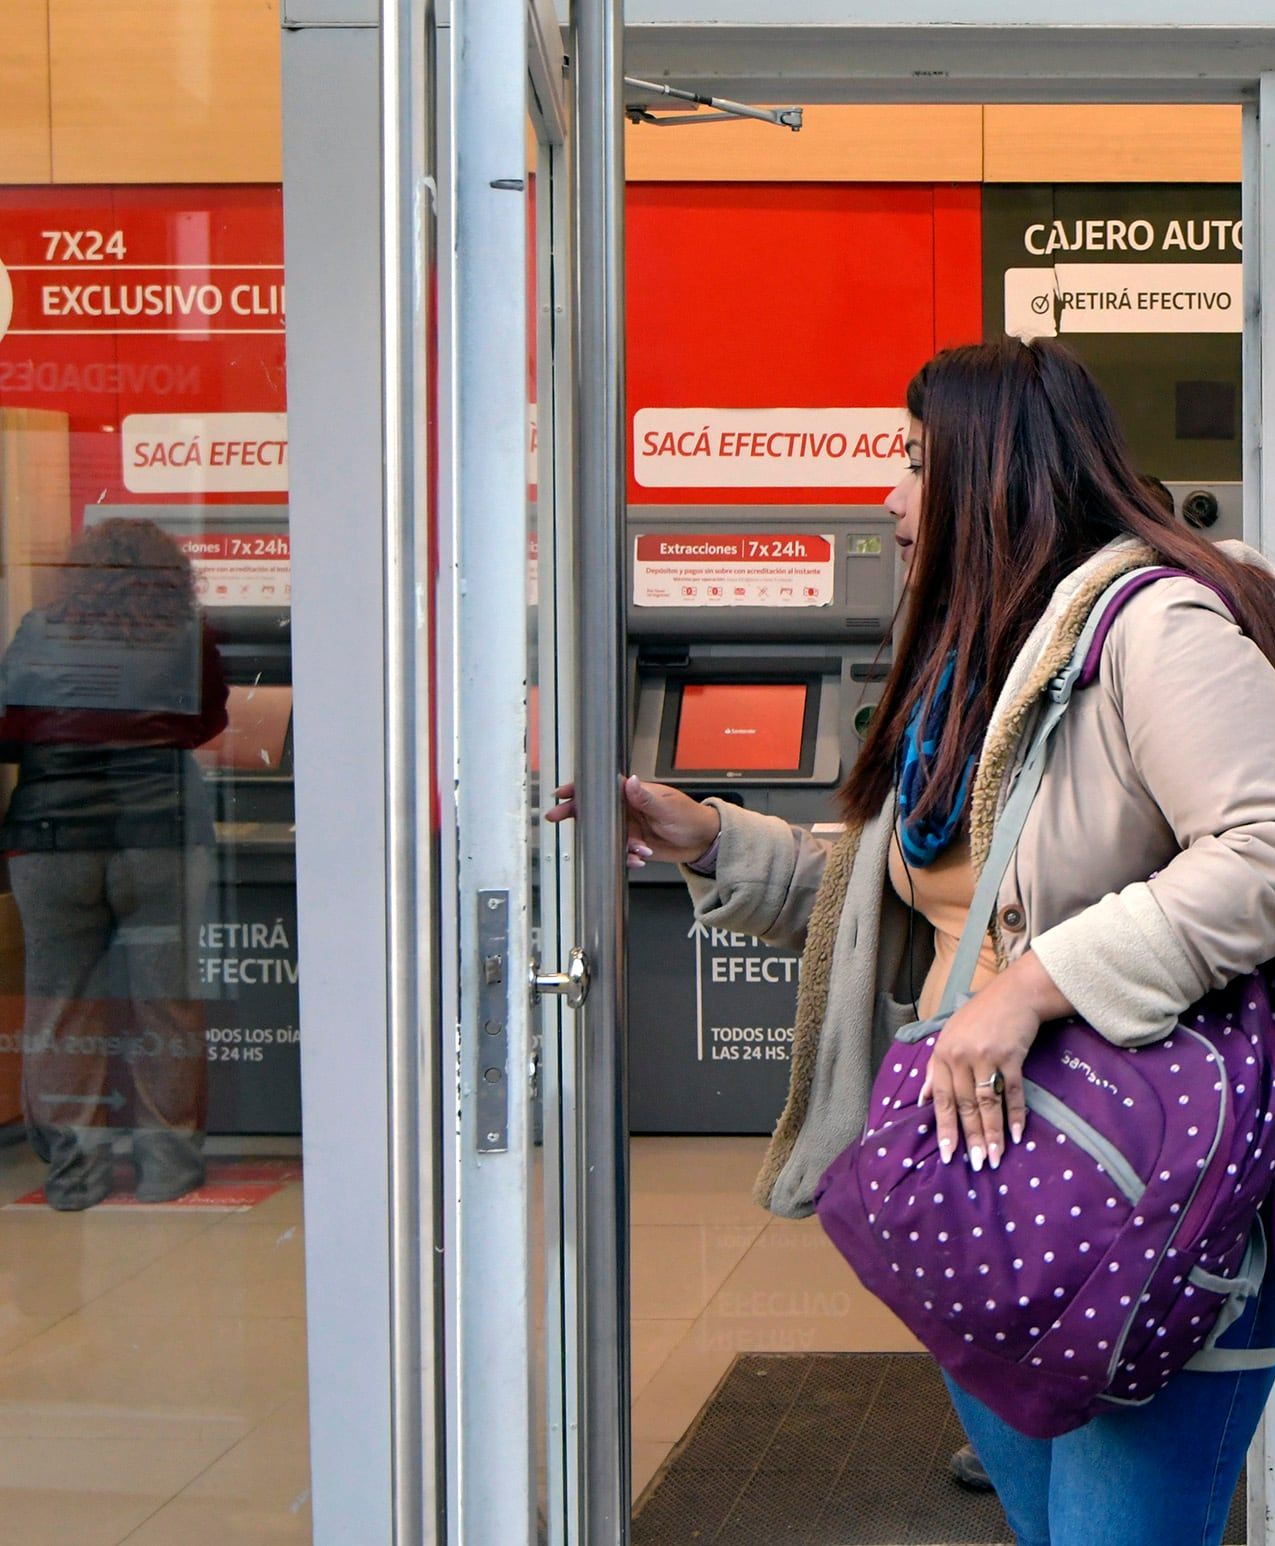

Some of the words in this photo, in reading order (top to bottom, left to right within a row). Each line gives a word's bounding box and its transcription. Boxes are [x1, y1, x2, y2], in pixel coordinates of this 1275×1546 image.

[41, 230, 127, 261] 7X24
[1024, 219, 1155, 256] CAJERO
[42, 285, 222, 316] EXCLUSIVO
[1061, 288, 1132, 310] RETIRÁ
[1137, 291, 1232, 310] EFECTIVO
[134, 436, 202, 468] SACÁ
[642, 425, 711, 457] SACÁ
[718, 431, 848, 458] EFECTIVO
[852, 427, 906, 458] ACÁ
[660, 542, 738, 555] Extracciones
[245, 1028, 274, 1043] LOS
[711, 1027, 764, 1042] TODOS
[767, 1027, 795, 1042] LOS
[220, 1047, 240, 1062] 24
[711, 1046, 740, 1061] LAS
[742, 1046, 762, 1061] 24
[765, 1046, 790, 1061] HS.
